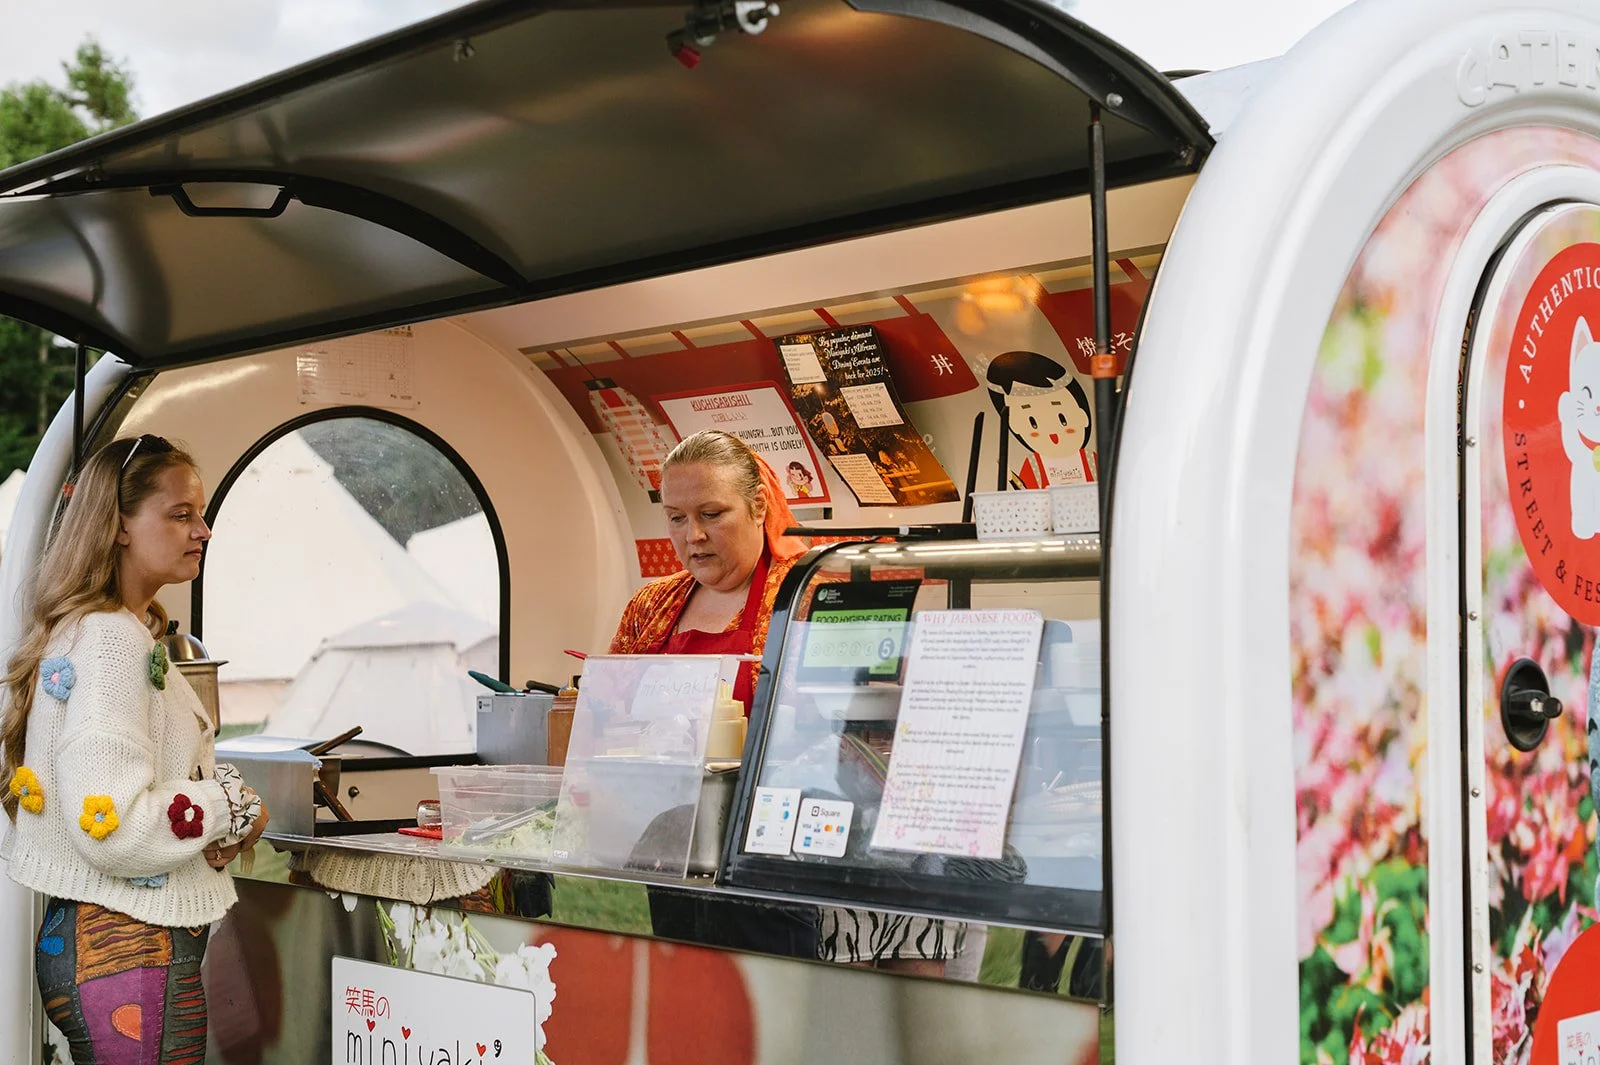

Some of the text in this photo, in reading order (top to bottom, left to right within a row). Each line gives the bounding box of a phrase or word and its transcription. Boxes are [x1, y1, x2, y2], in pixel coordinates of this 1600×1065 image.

[818, 336, 830, 347] By
[850, 328, 872, 340] demand
[832, 359, 853, 370] Dining
[851, 356, 871, 367] Events
[844, 365, 884, 380] back for 2025!
[784, 425, 799, 436] YOU
[771, 441, 779, 451] IS
[779, 439, 805, 451] LONELY!
[1515, 433, 1553, 556] STREET
[1555, 559, 1566, 584] &
[815, 613, 902, 624] FOOD HYGIENE RATING
[924, 613, 946, 623] WHY
[950, 612, 997, 624] JAPANESE
[880, 639, 893, 659] 5
[820, 808, 841, 817] Square
[345, 986, 390, 1019] 笑馬の
